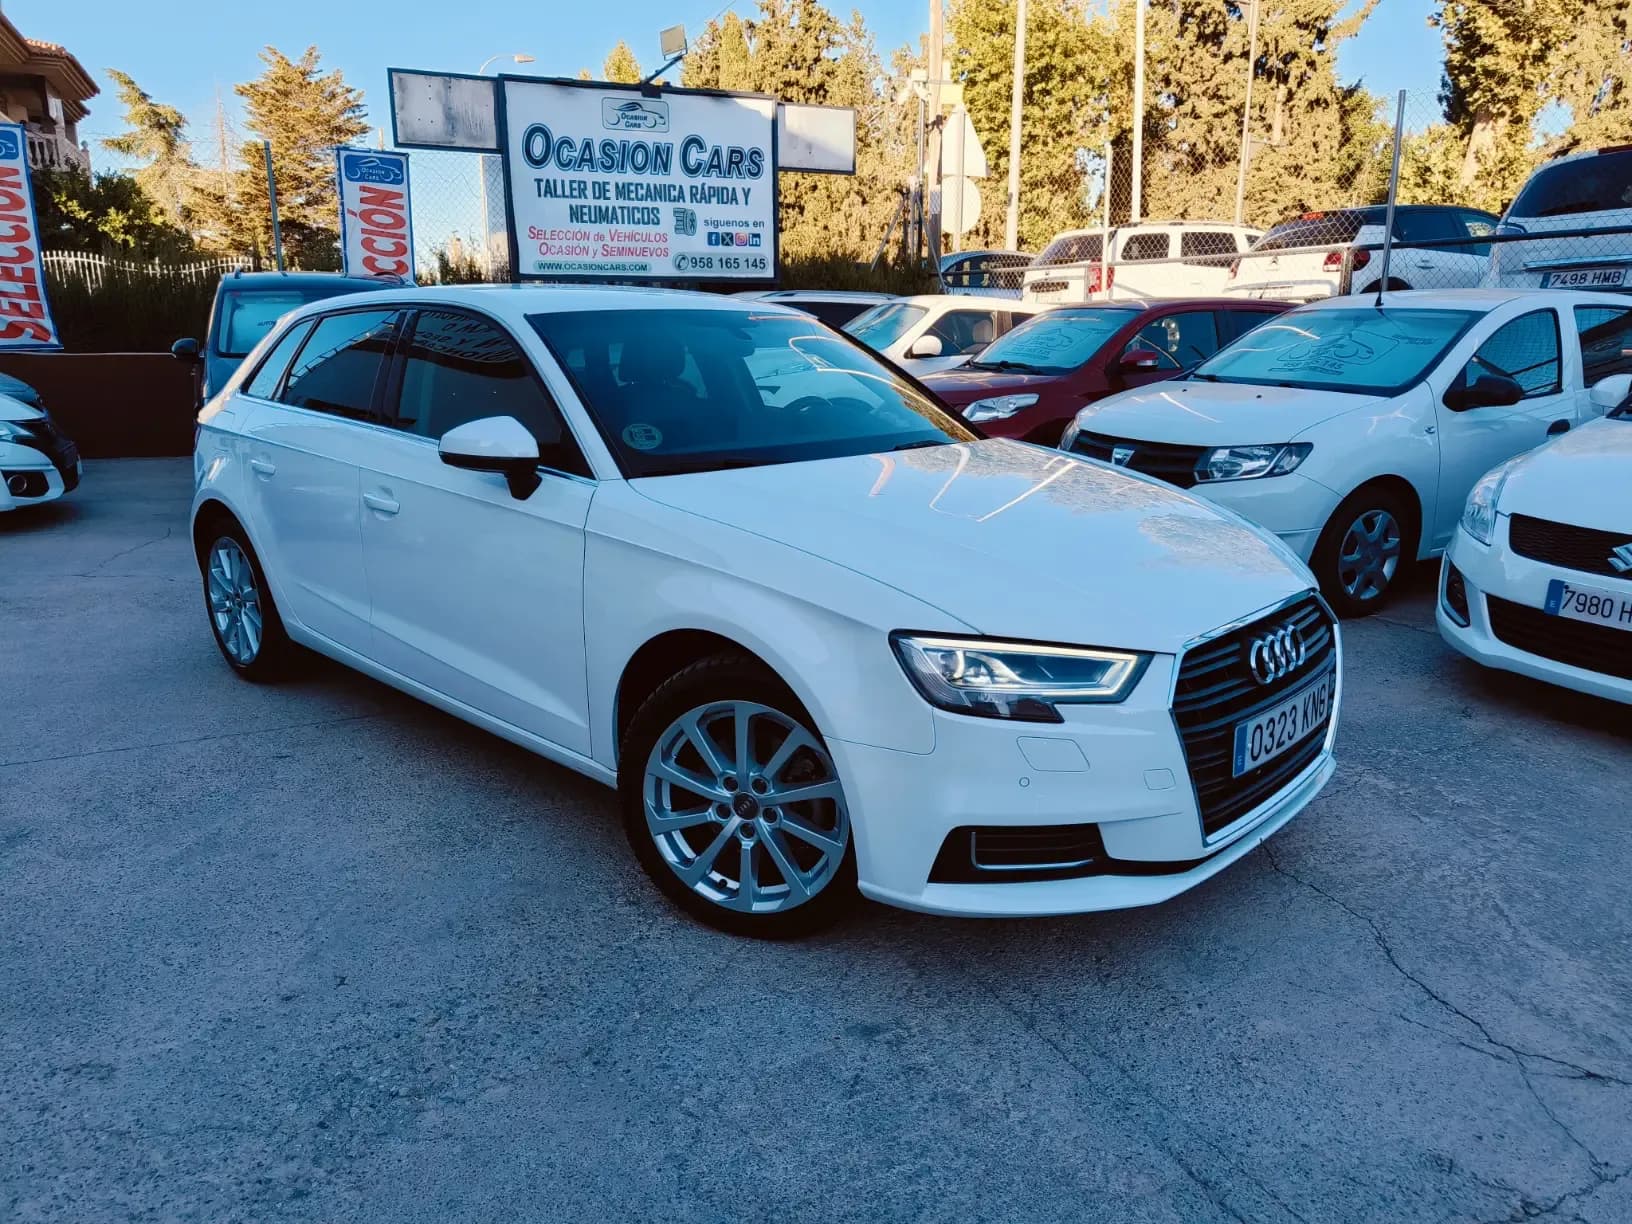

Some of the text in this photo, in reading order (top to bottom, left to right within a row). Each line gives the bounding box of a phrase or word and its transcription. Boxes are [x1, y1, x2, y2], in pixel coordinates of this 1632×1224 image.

[522, 123, 765, 180] OCASION CARS
[534, 178, 751, 206] TALLER DE MECANICA RÁPIDA Y
[569, 204, 661, 226] NEUMATICOS
[752, 220, 765, 228] en
[528, 226, 669, 243] SELECCIÓN de VEHÍCULOS
[538, 242, 670, 259] OCASIÓN y SEMINUEVOS
[538, 262, 648, 272] WWW.OCASIONCARS.COM
[690, 256, 766, 270] 958 165 145
[1551, 271, 1622, 286] 7498 HMB
[1562, 589, 1614, 618] 7980
[1250, 683, 1327, 762] 0323 KNG
